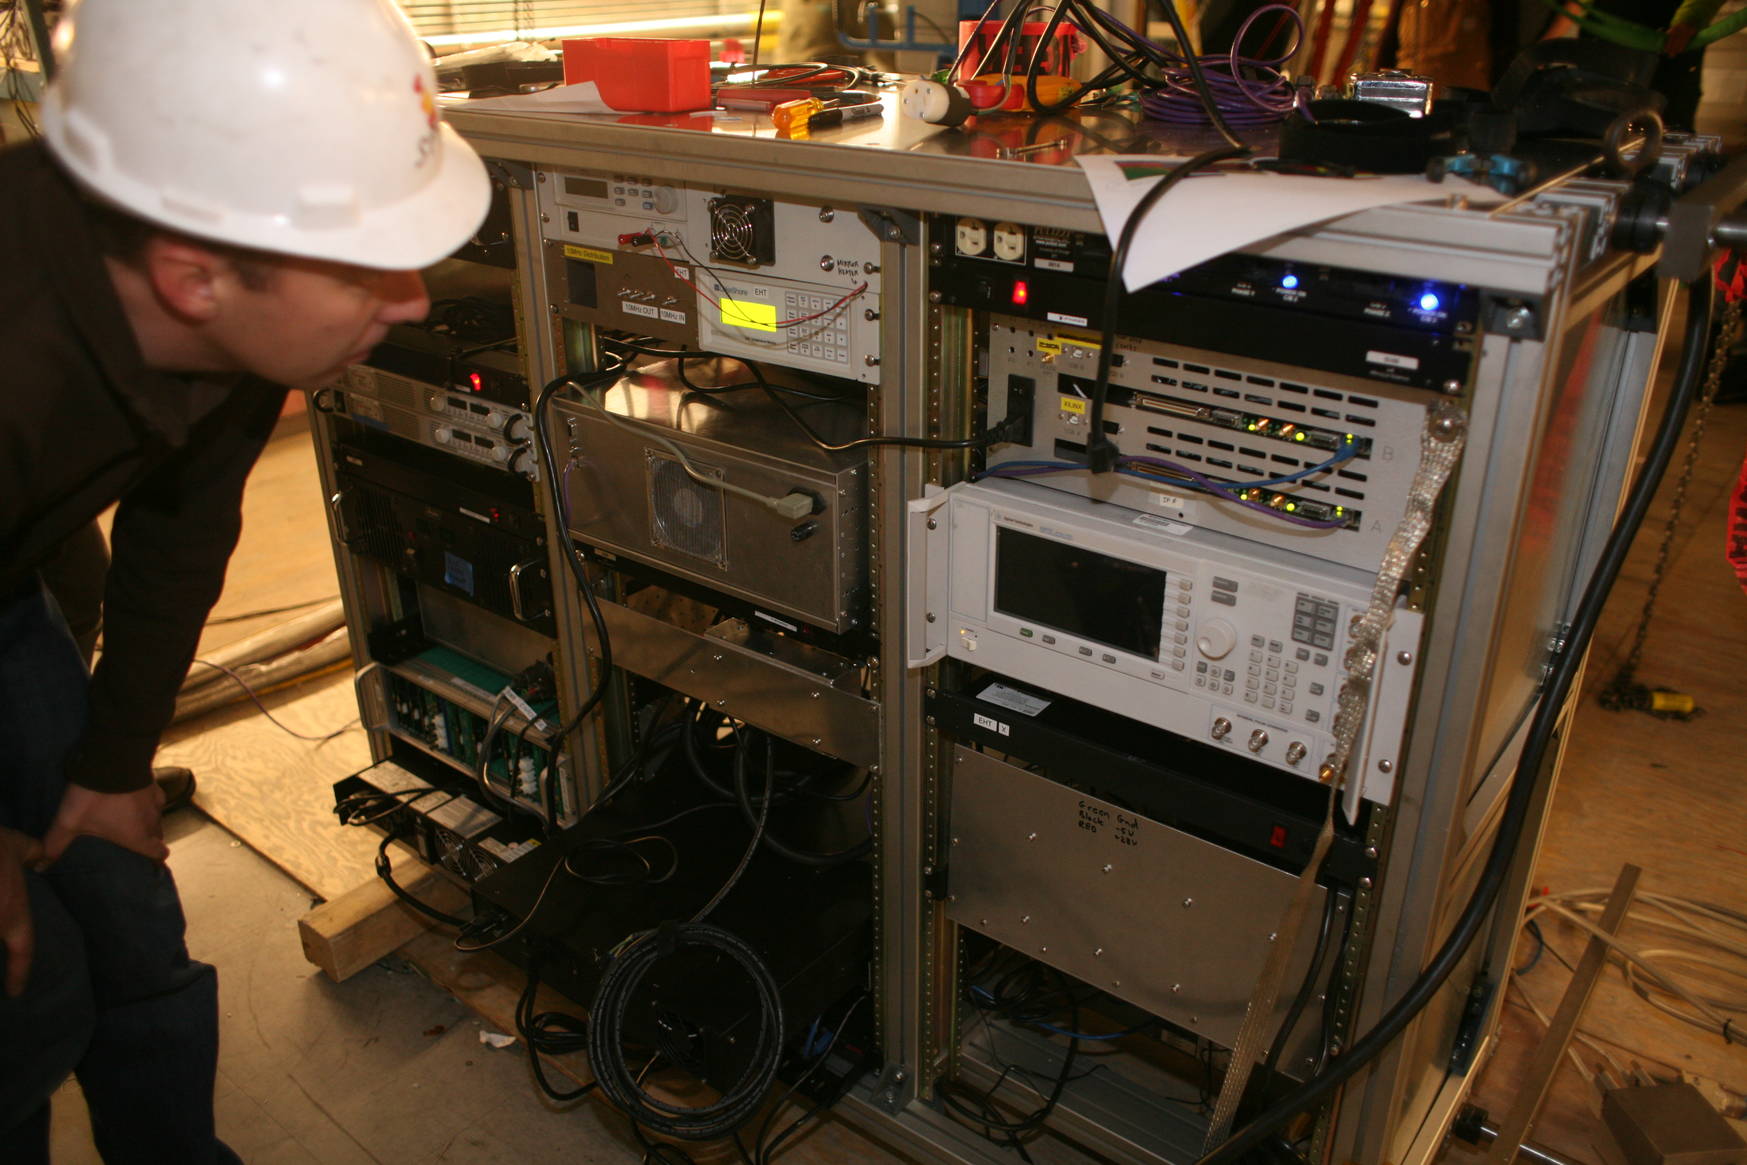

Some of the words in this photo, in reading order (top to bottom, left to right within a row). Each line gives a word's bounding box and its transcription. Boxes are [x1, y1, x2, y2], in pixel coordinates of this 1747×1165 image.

[754, 288, 767, 297] EHT
[643, 306, 654, 315] OUT
[679, 313, 685, 321] IN
[1382, 445, 1394, 461] B
[1370, 520, 1382, 533] A
[978, 716, 992, 727] EHT
[1078, 800, 1110, 819] Green
[1117, 814, 1139, 830] Gnd
[1079, 810, 1104, 826] Black
